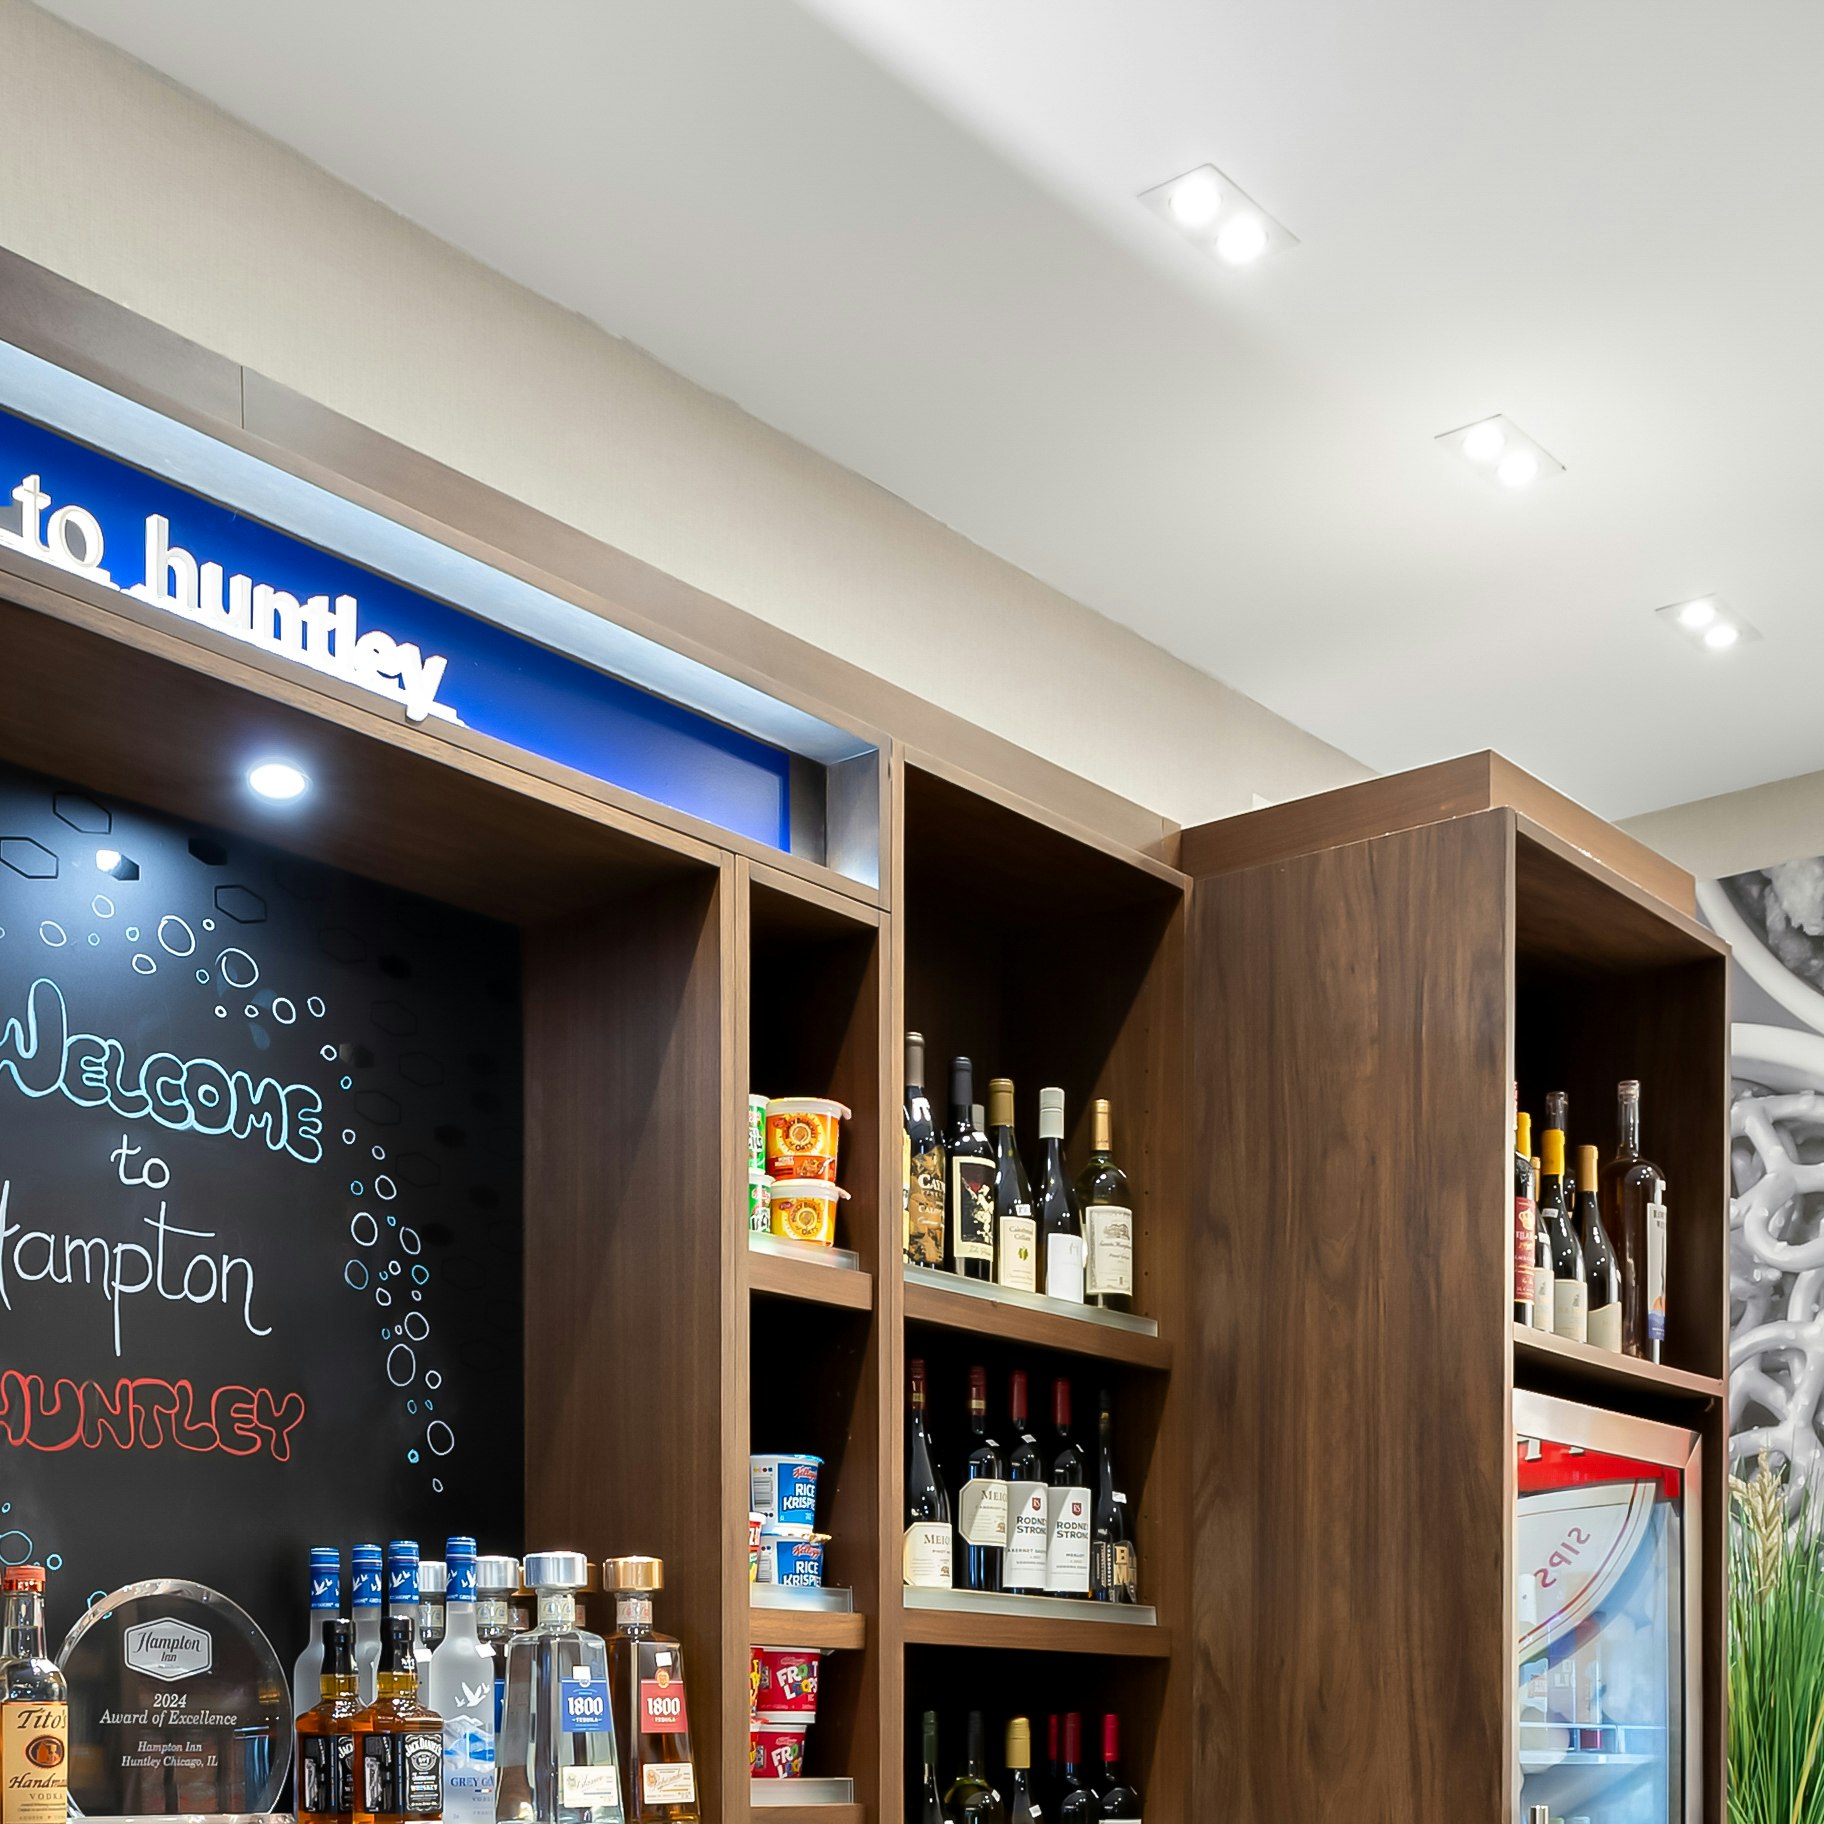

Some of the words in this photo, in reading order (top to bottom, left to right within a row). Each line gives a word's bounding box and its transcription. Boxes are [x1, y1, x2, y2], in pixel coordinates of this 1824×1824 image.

[12, 474, 106, 570] to
[145, 513, 448, 722] huntley
[110, 1134, 170, 1188] to
[795, 1483, 816, 1498] RICE
[133, 1630, 202, 1655] Hampton
[160, 1651, 178, 1663] Inn
[152, 1693, 187, 1709] 2024
[567, 1697, 603, 1715] 1800
[647, 1697, 680, 1715] 1800
[99, 1710, 147, 1725] Award
[151, 1710, 166, 1727] of
[169, 1710, 238, 1726] Excellence
[137, 1741, 180, 1755] Hampton
[183, 1741, 202, 1752] Inn
[121, 1756, 161, 1769] Huntley
[163, 1755, 205, 1769] Chicago,
[207, 1755, 218, 1767] IL
